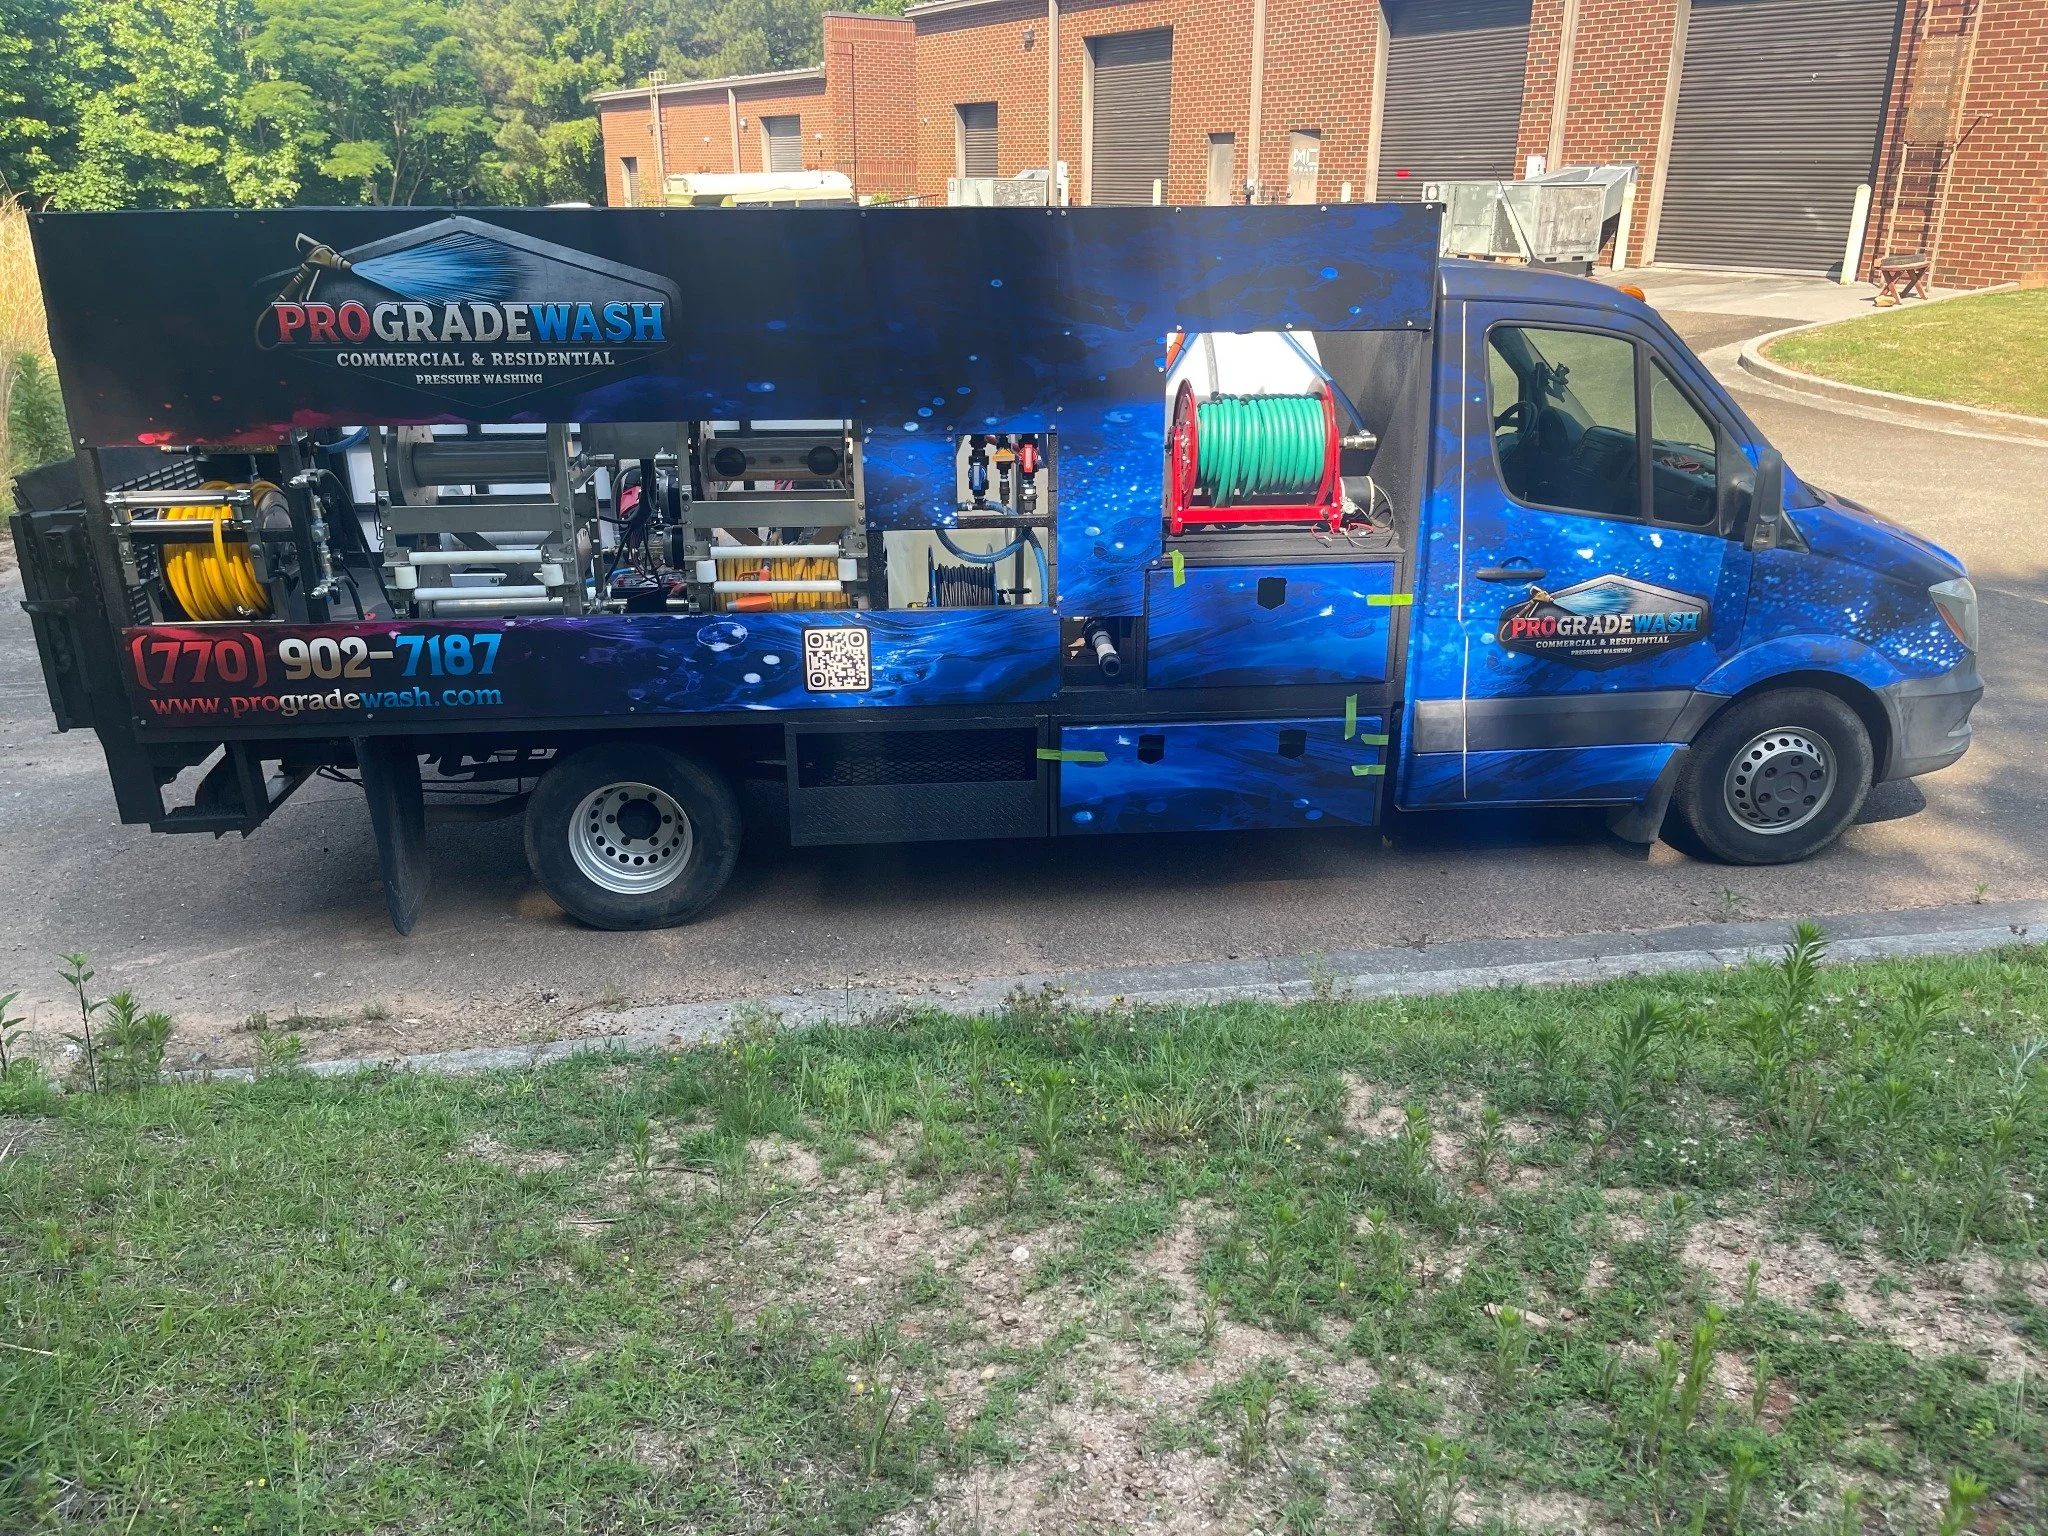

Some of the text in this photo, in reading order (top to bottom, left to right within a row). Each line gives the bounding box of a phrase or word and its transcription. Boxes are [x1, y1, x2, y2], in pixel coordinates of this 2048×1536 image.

[1294, 148, 1318, 166] MC
[271, 300, 668, 345] PROGRADEWASH
[336, 350, 616, 368] COMMERCIAL & RESIDENTIAL
[415, 372, 543, 386] PRESSURE WASHING
[1511, 611, 1699, 639] PROGRADEWASH
[1535, 635, 1670, 649] COMMERCIAL & RESIDENTIAL
[1570, 646, 1633, 656] PRESSURE WASHING
[131, 632, 503, 690] (770) 902-7187
[150, 687, 503, 717] www.progradewash.com
